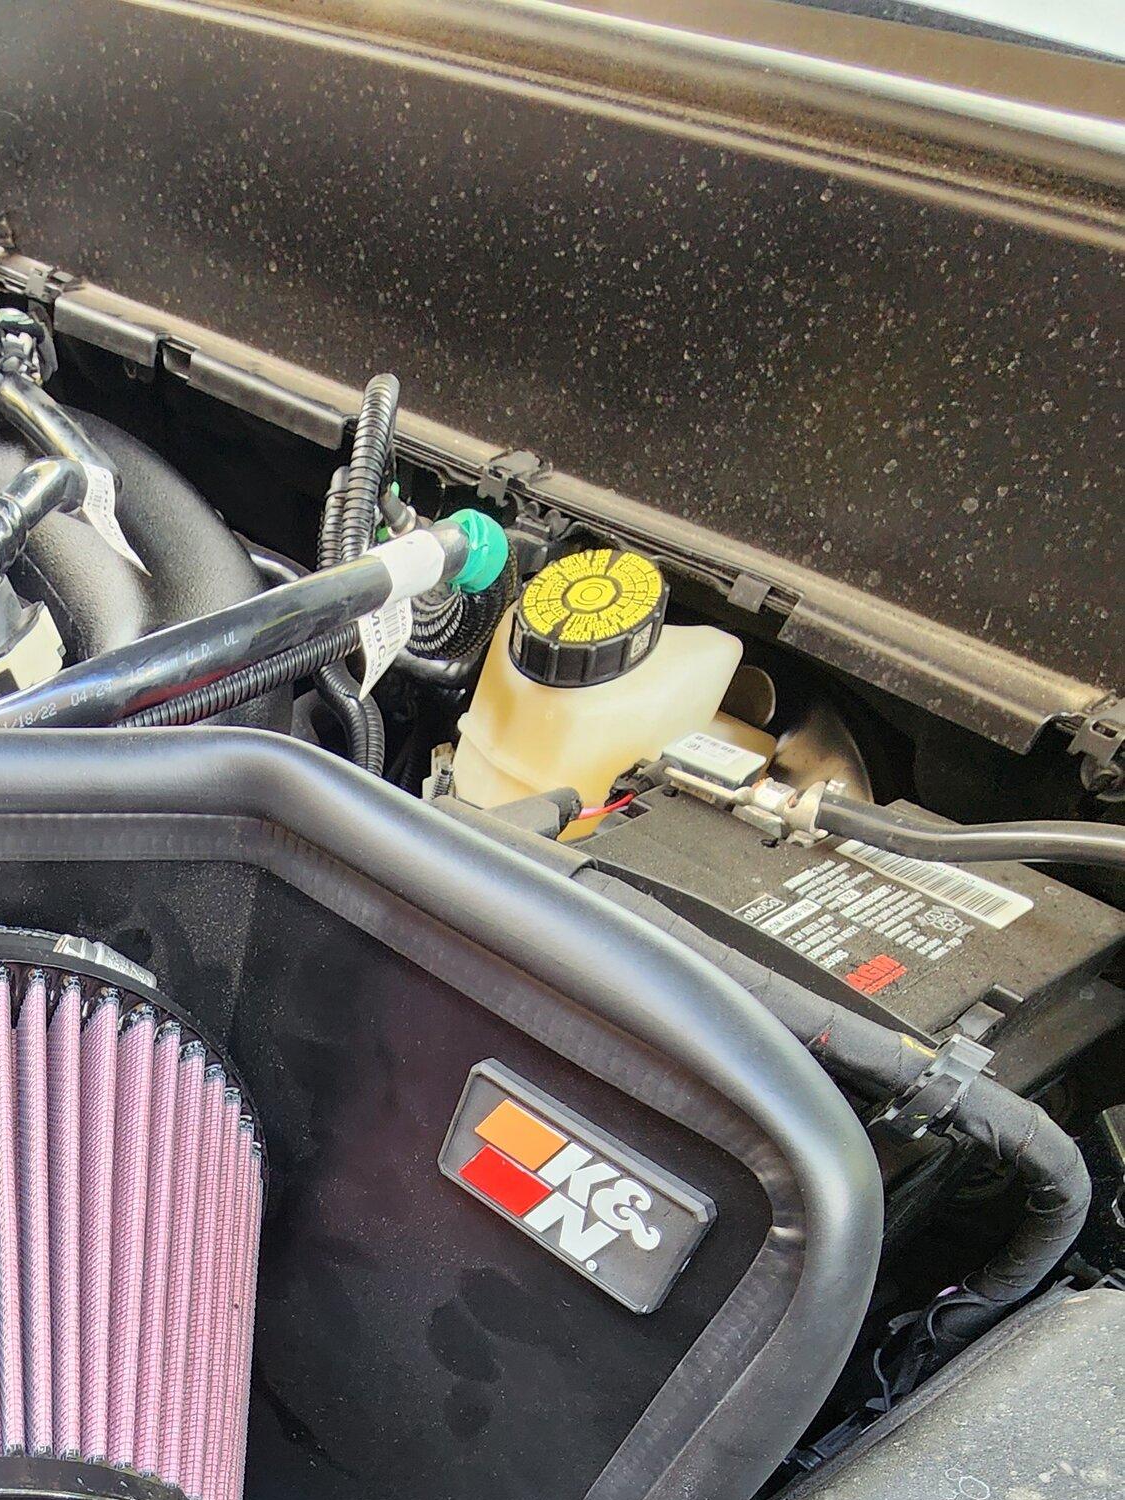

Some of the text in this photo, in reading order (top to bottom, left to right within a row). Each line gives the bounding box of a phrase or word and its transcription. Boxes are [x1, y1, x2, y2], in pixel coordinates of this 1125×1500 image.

[742, 898, 780, 921] oMoCo
[845, 953, 901, 991] AGM
[523, 1142, 661, 1262] K&N
